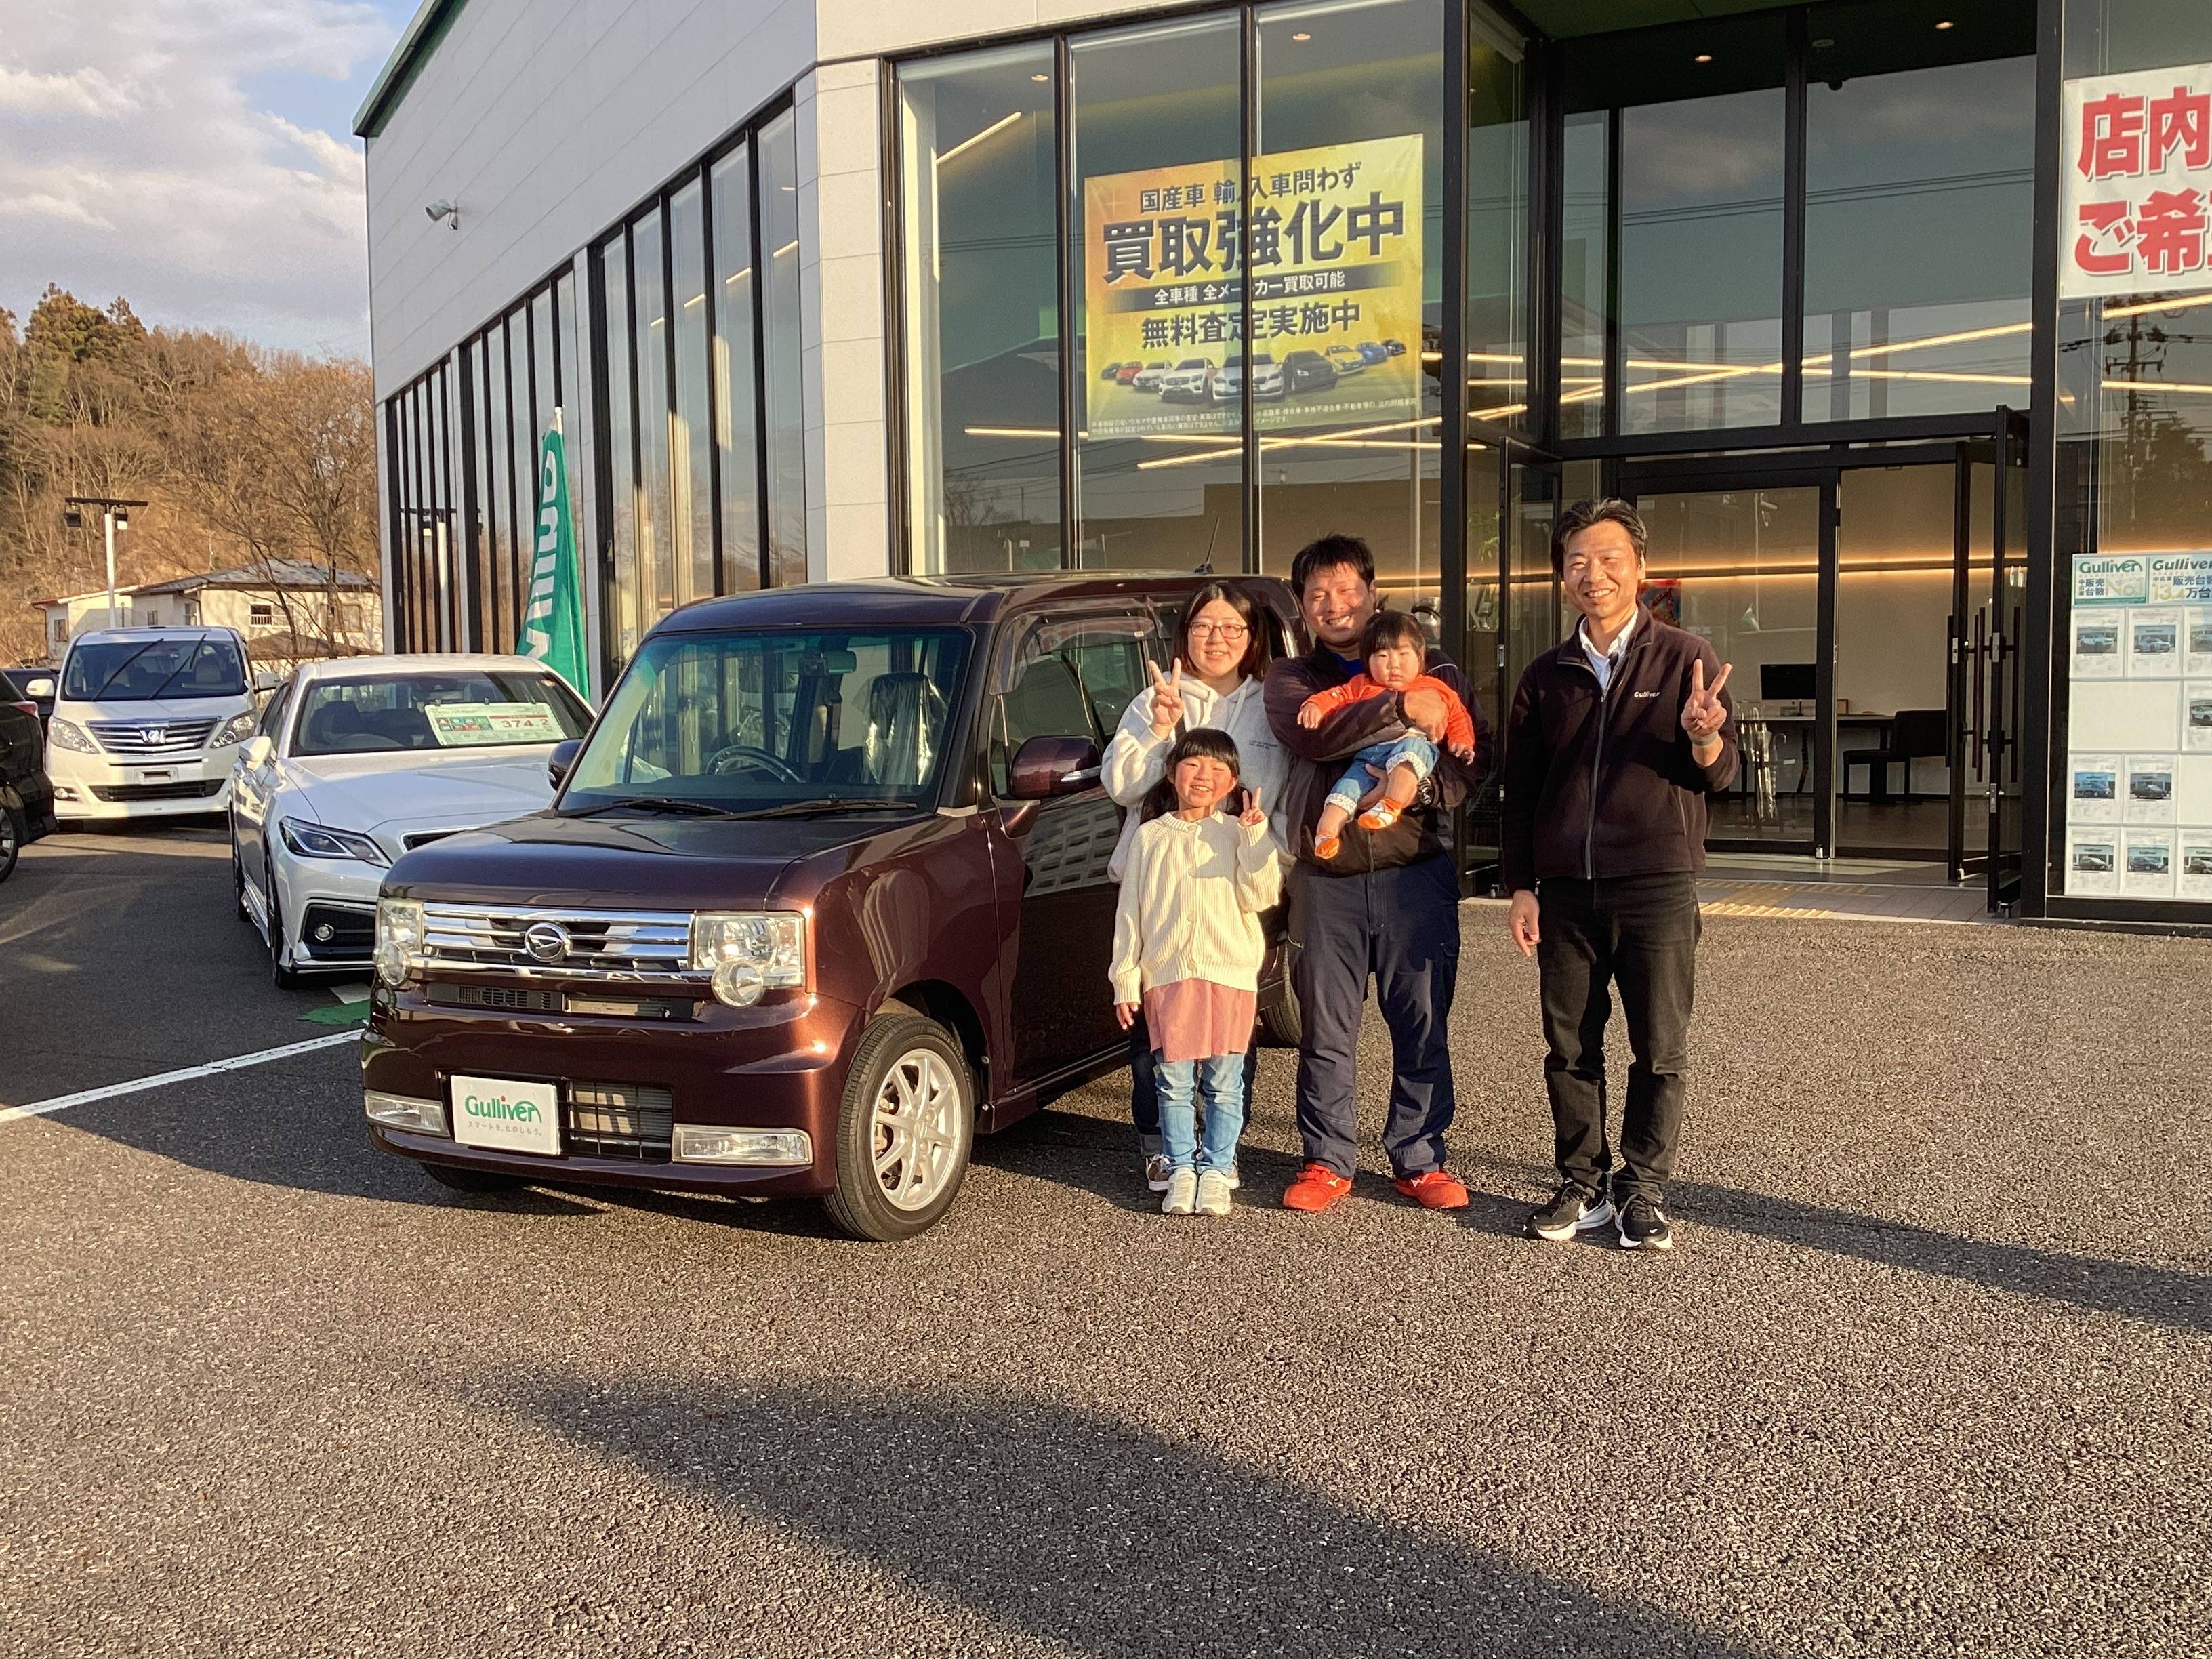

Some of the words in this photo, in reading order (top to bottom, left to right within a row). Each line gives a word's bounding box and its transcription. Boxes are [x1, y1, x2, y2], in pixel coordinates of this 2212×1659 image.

[2077, 85, 2211, 178] 店内
[1140, 183, 1205, 214] 国産車
[1213, 161, 1362, 205] 輸入車問わず
[1103, 190, 1404, 285] 買取強化中
[2075, 187, 2212, 272] ご希
[1154, 286, 1198, 306] 全車種
[1141, 299, 1361, 350] 無料査定実施中
[2078, 560, 2143, 574] Gulliver
[501, 718, 549, 728] 374.2
[465, 1095, 542, 1123] Gulliver
